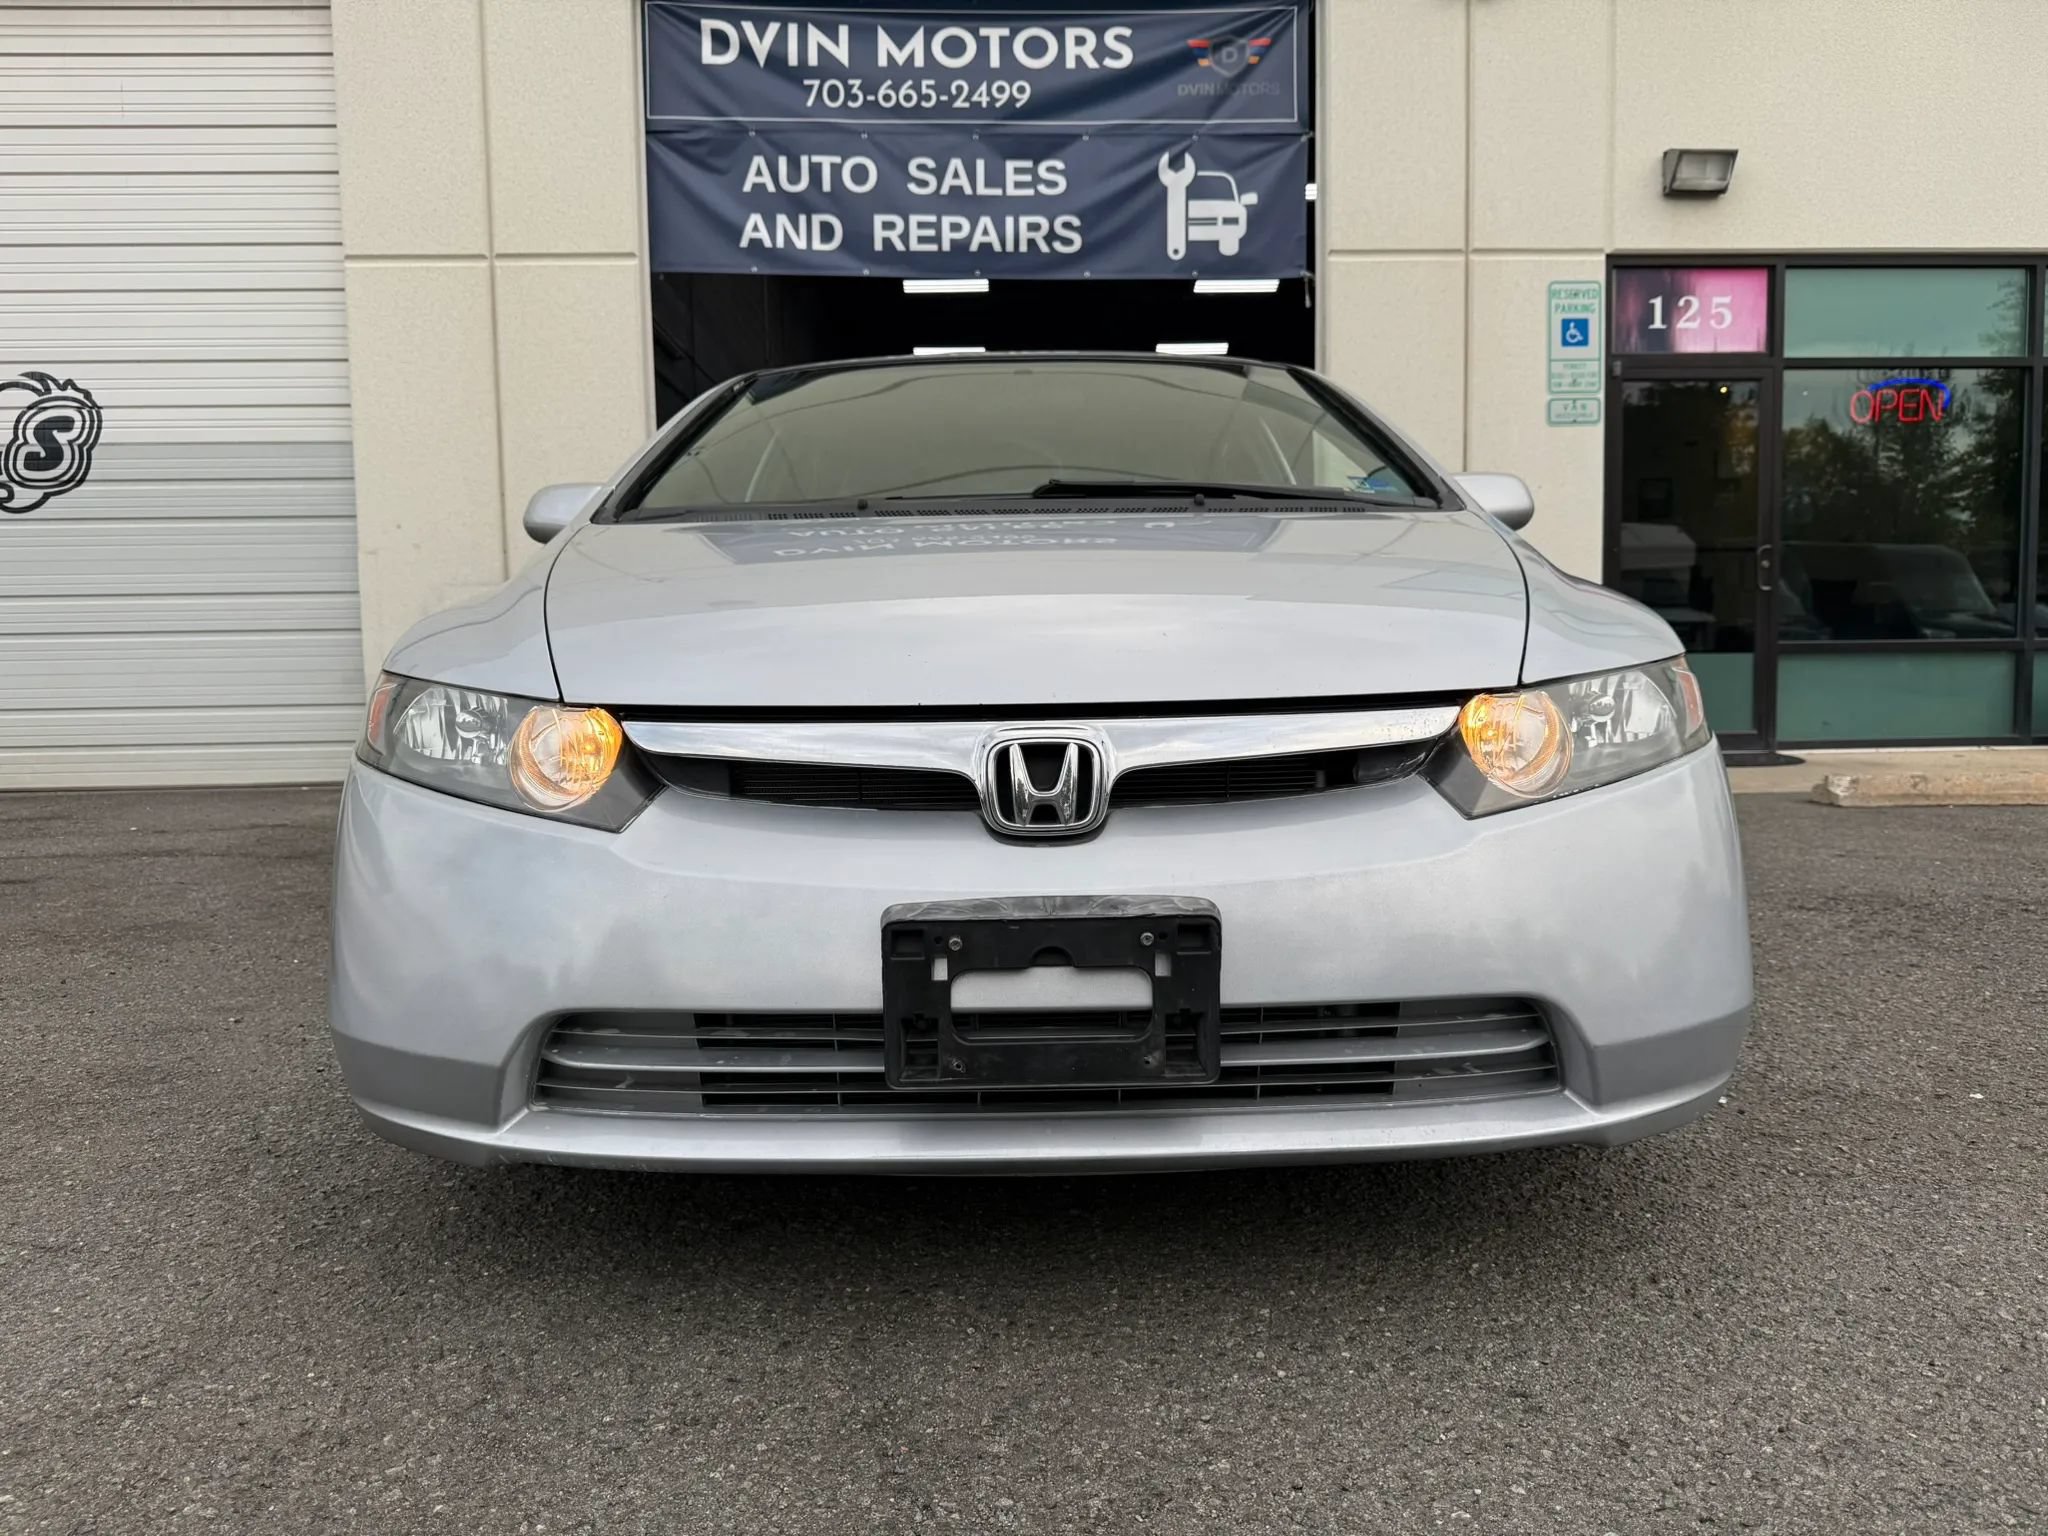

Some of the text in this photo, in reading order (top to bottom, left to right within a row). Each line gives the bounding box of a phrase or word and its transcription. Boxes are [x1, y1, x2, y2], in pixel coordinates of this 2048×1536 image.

[700, 19, 1135, 70] DVIN MOTORS
[802, 78, 1032, 110] 703-665-2499
[742, 153, 1068, 197] AUTO SALES
[739, 213, 1083, 254] AND REPAIRS
[1648, 295, 1733, 329] 125
[1849, 388, 1944, 424] OPEN
